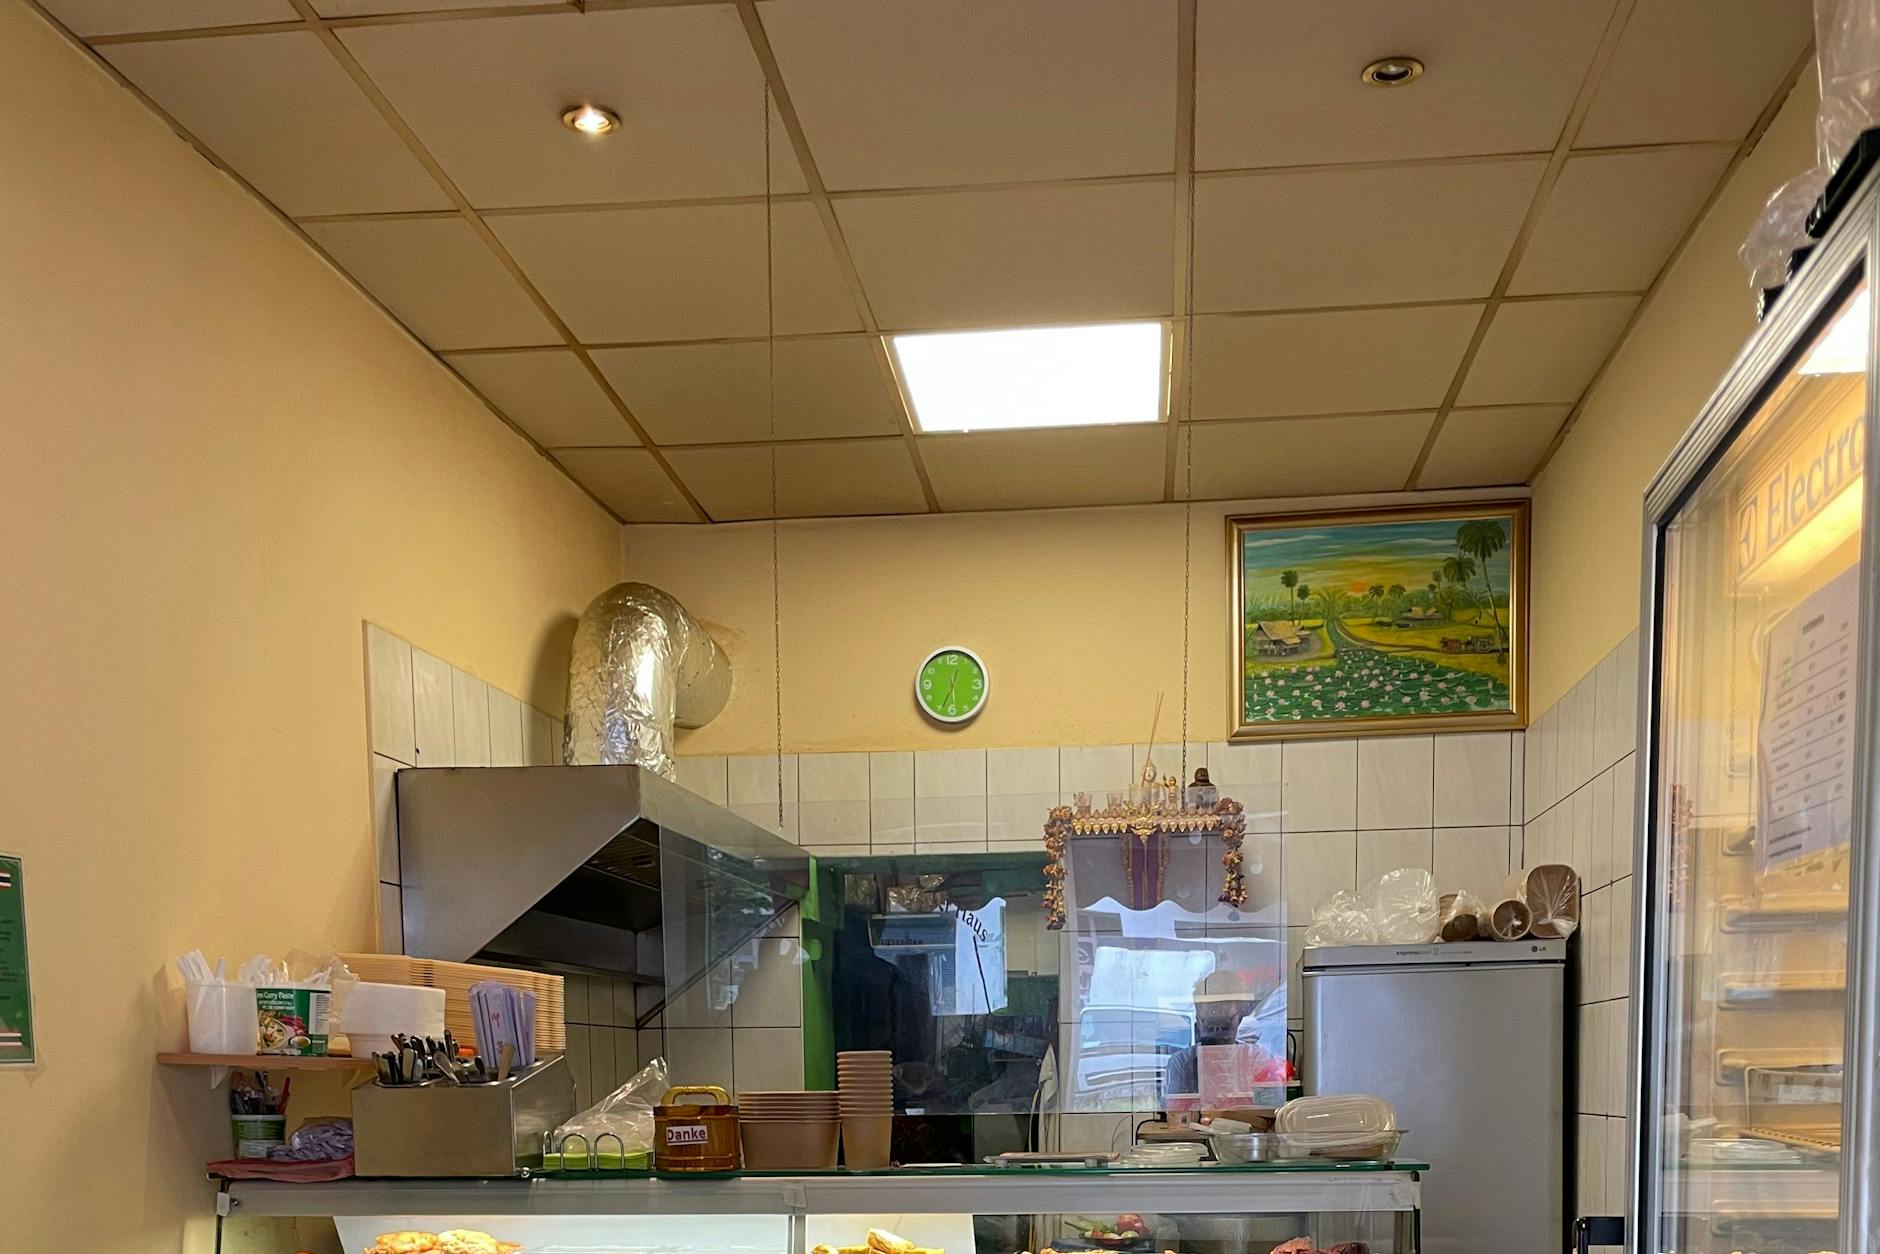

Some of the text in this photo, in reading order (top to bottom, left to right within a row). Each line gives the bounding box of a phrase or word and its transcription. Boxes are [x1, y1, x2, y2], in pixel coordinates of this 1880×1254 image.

[946, 654, 959, 665] 12
[923, 679, 933, 690] 9
[971, 679, 982, 690] 3
[947, 704, 957, 716] 6
[667, 1127, 706, 1141] Danke
